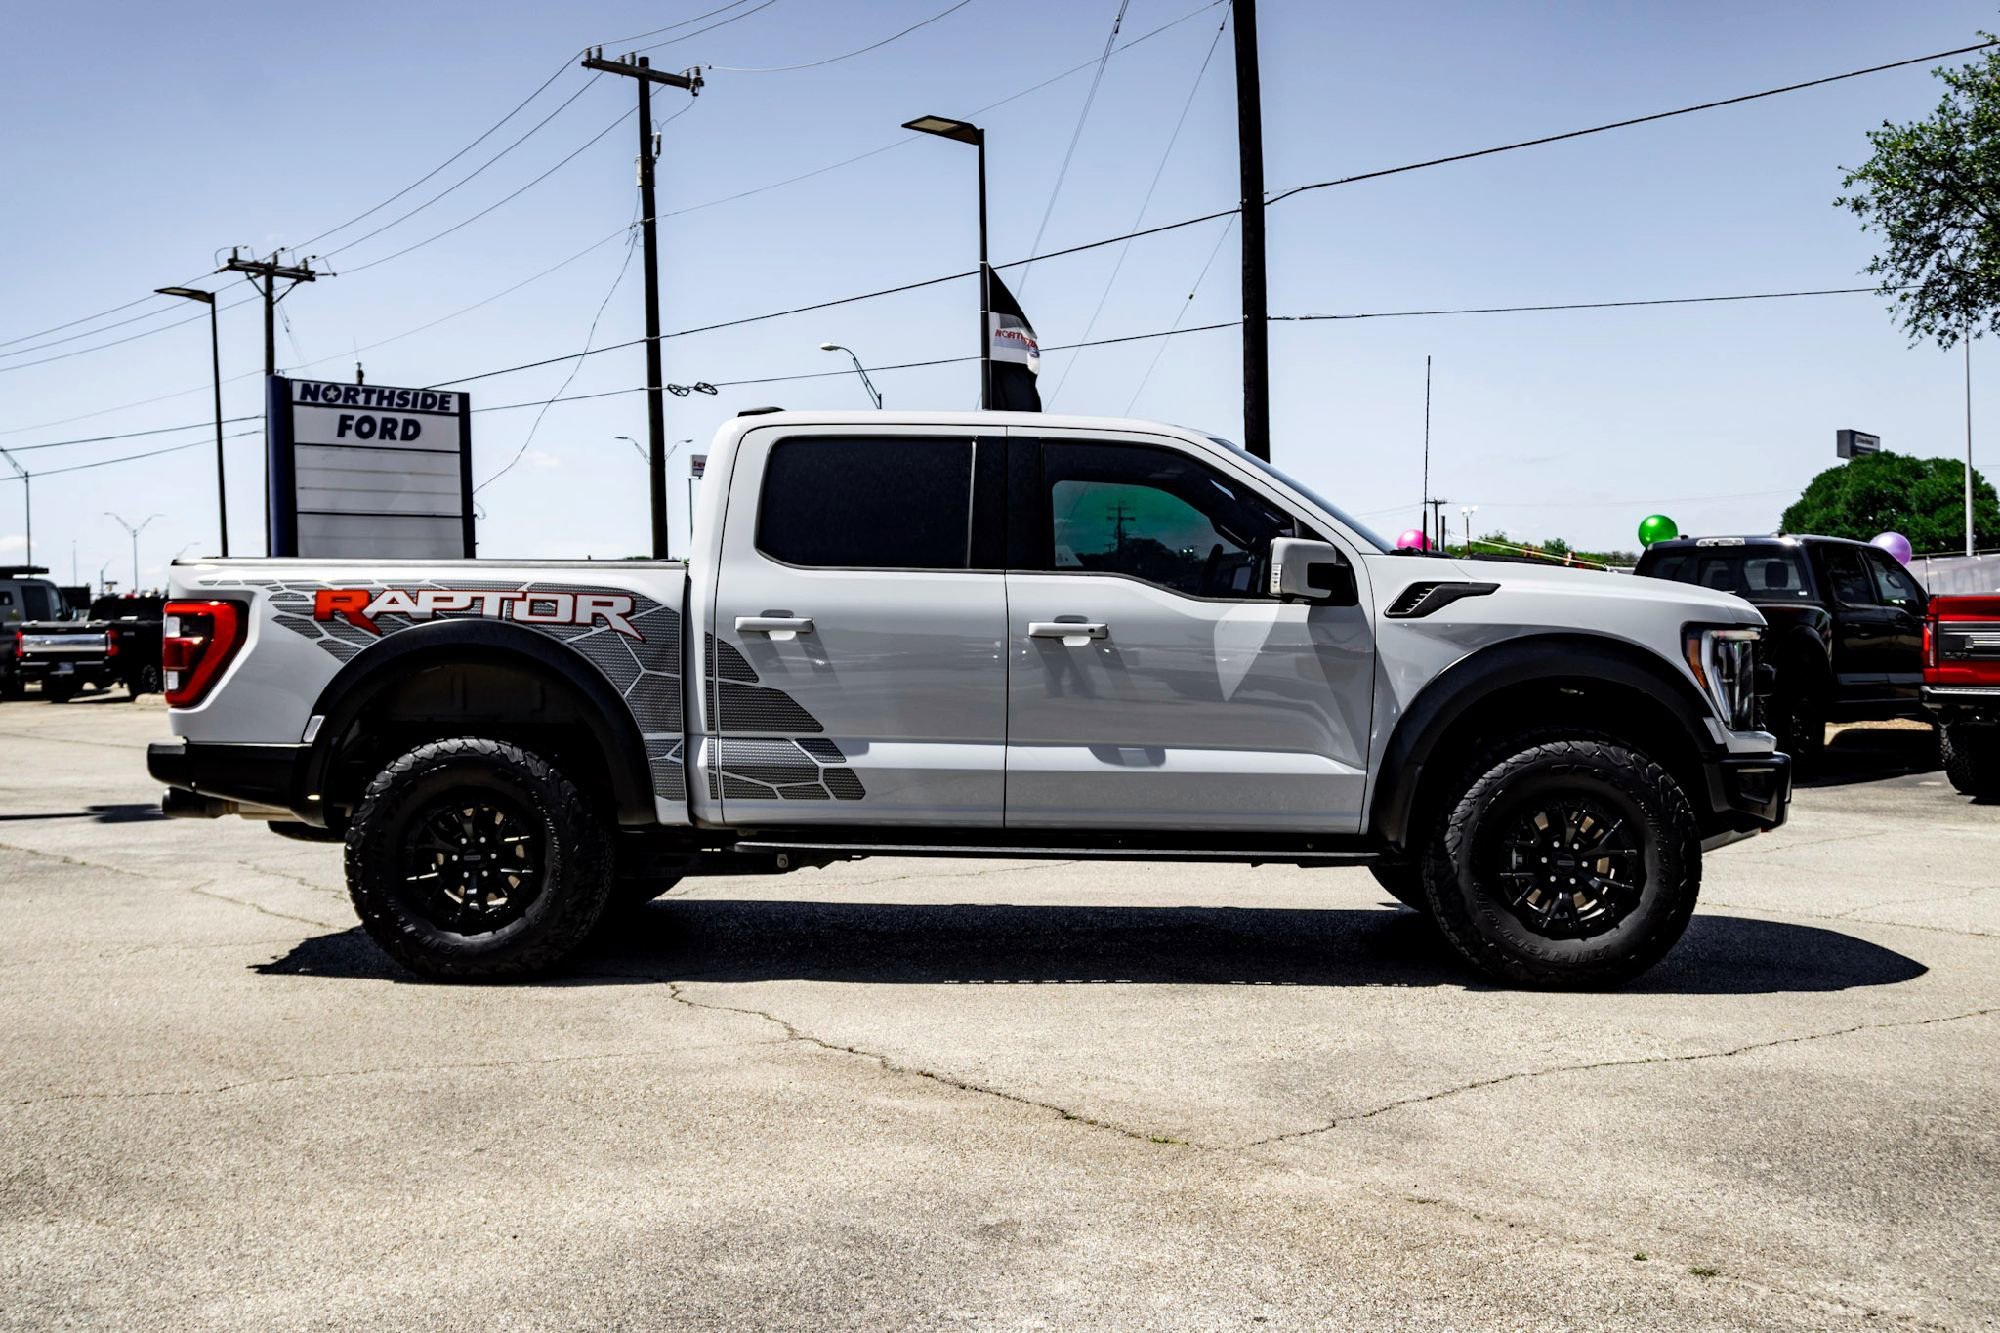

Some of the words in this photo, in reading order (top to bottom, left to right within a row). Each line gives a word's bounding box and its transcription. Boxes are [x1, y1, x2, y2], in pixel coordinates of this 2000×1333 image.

[300, 383, 452, 411] NORTHSIDE
[336, 414, 421, 441] FORD
[313, 589, 646, 643] RAPTOR
